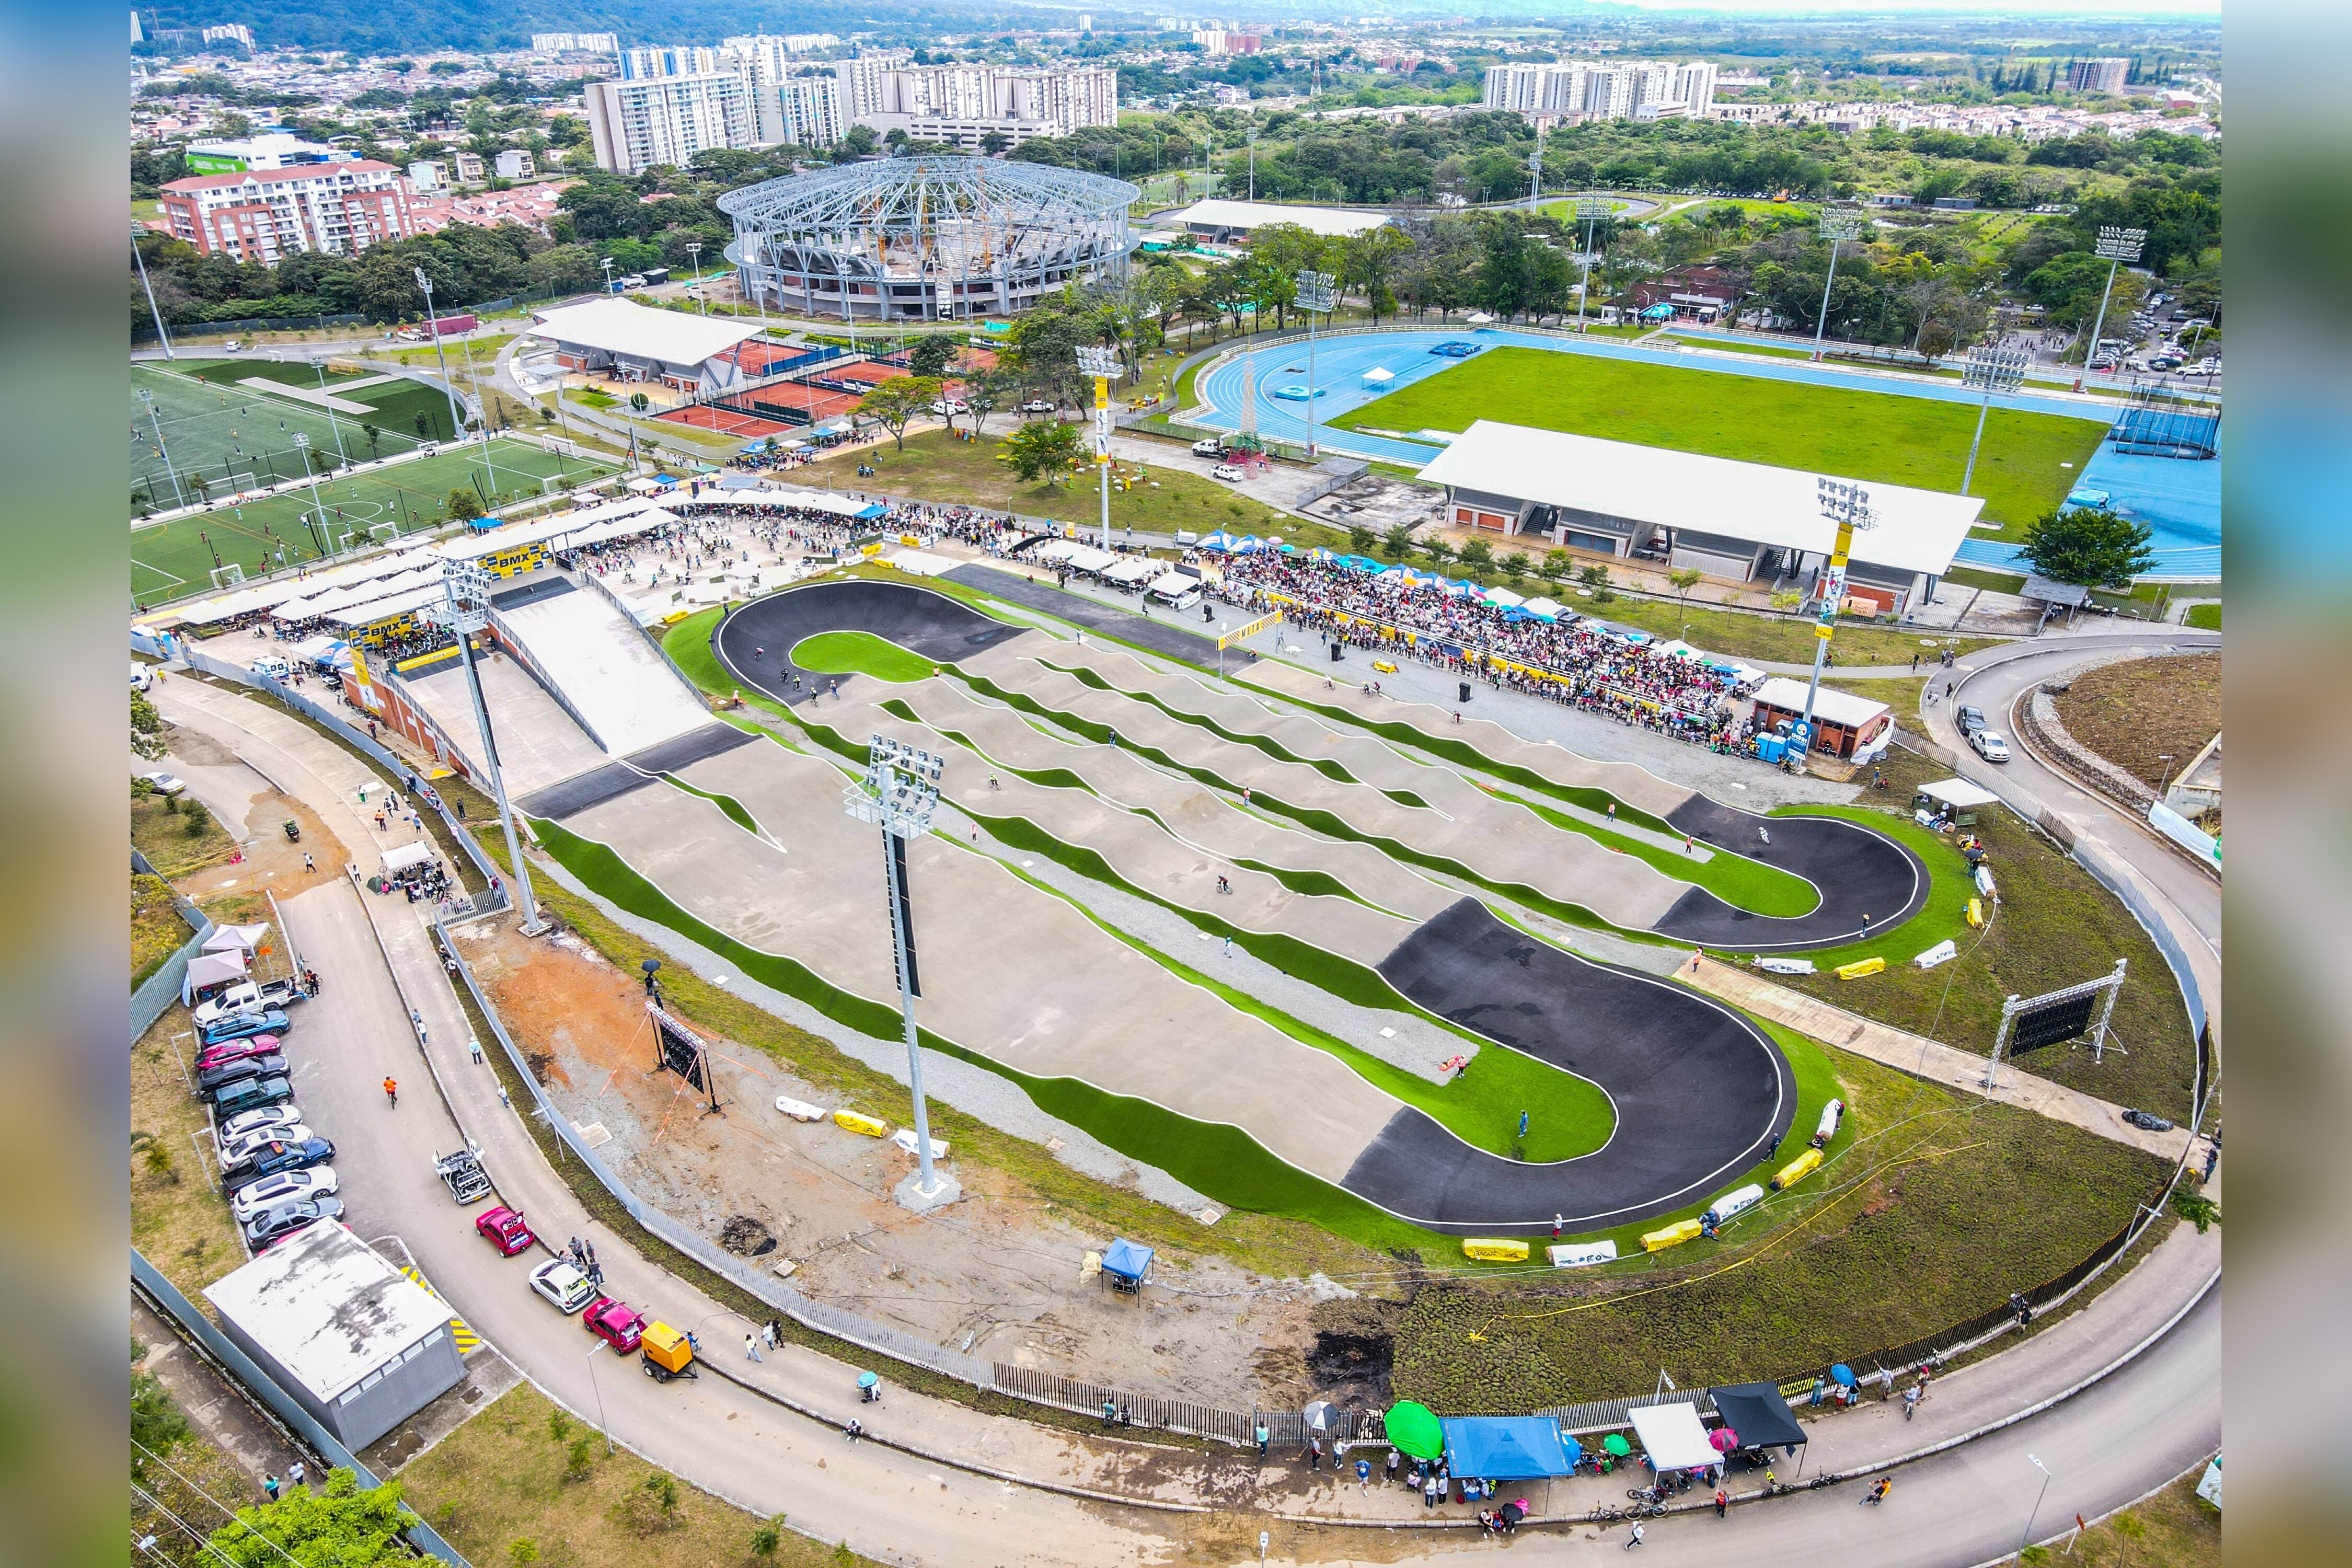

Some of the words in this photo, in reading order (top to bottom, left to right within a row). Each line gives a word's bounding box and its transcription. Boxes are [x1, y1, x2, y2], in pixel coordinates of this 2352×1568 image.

[499, 552, 530, 568] BMX
[371, 622, 401, 637] BMX
[1241, 622, 1260, 638] META
